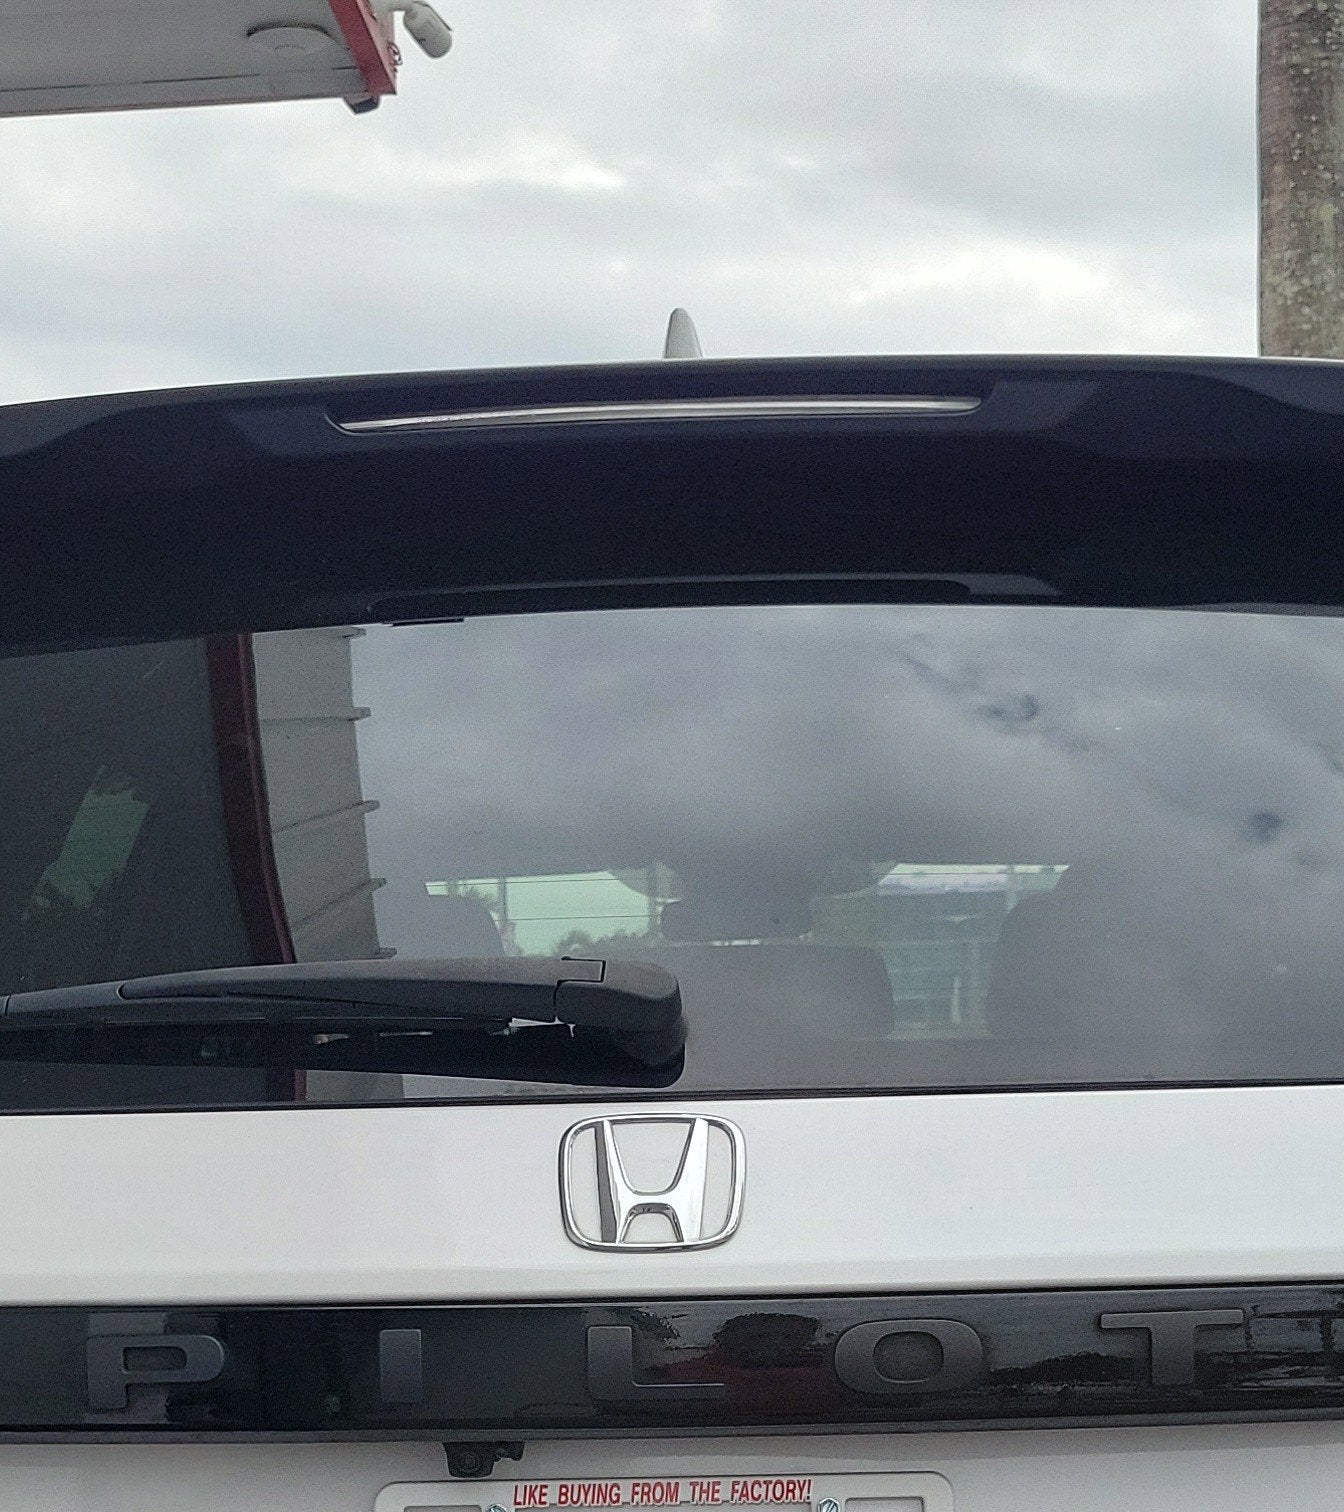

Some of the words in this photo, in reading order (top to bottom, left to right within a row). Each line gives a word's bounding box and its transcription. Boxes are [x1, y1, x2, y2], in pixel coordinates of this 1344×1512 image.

[87, 1309, 1245, 1411] PILOT
[513, 1484, 549, 1506] LIKE
[557, 1482, 622, 1505] BUYING
[631, 1481, 680, 1505] FROM
[689, 1480, 722, 1503] THE
[730, 1479, 812, 1502] FACTORY!
